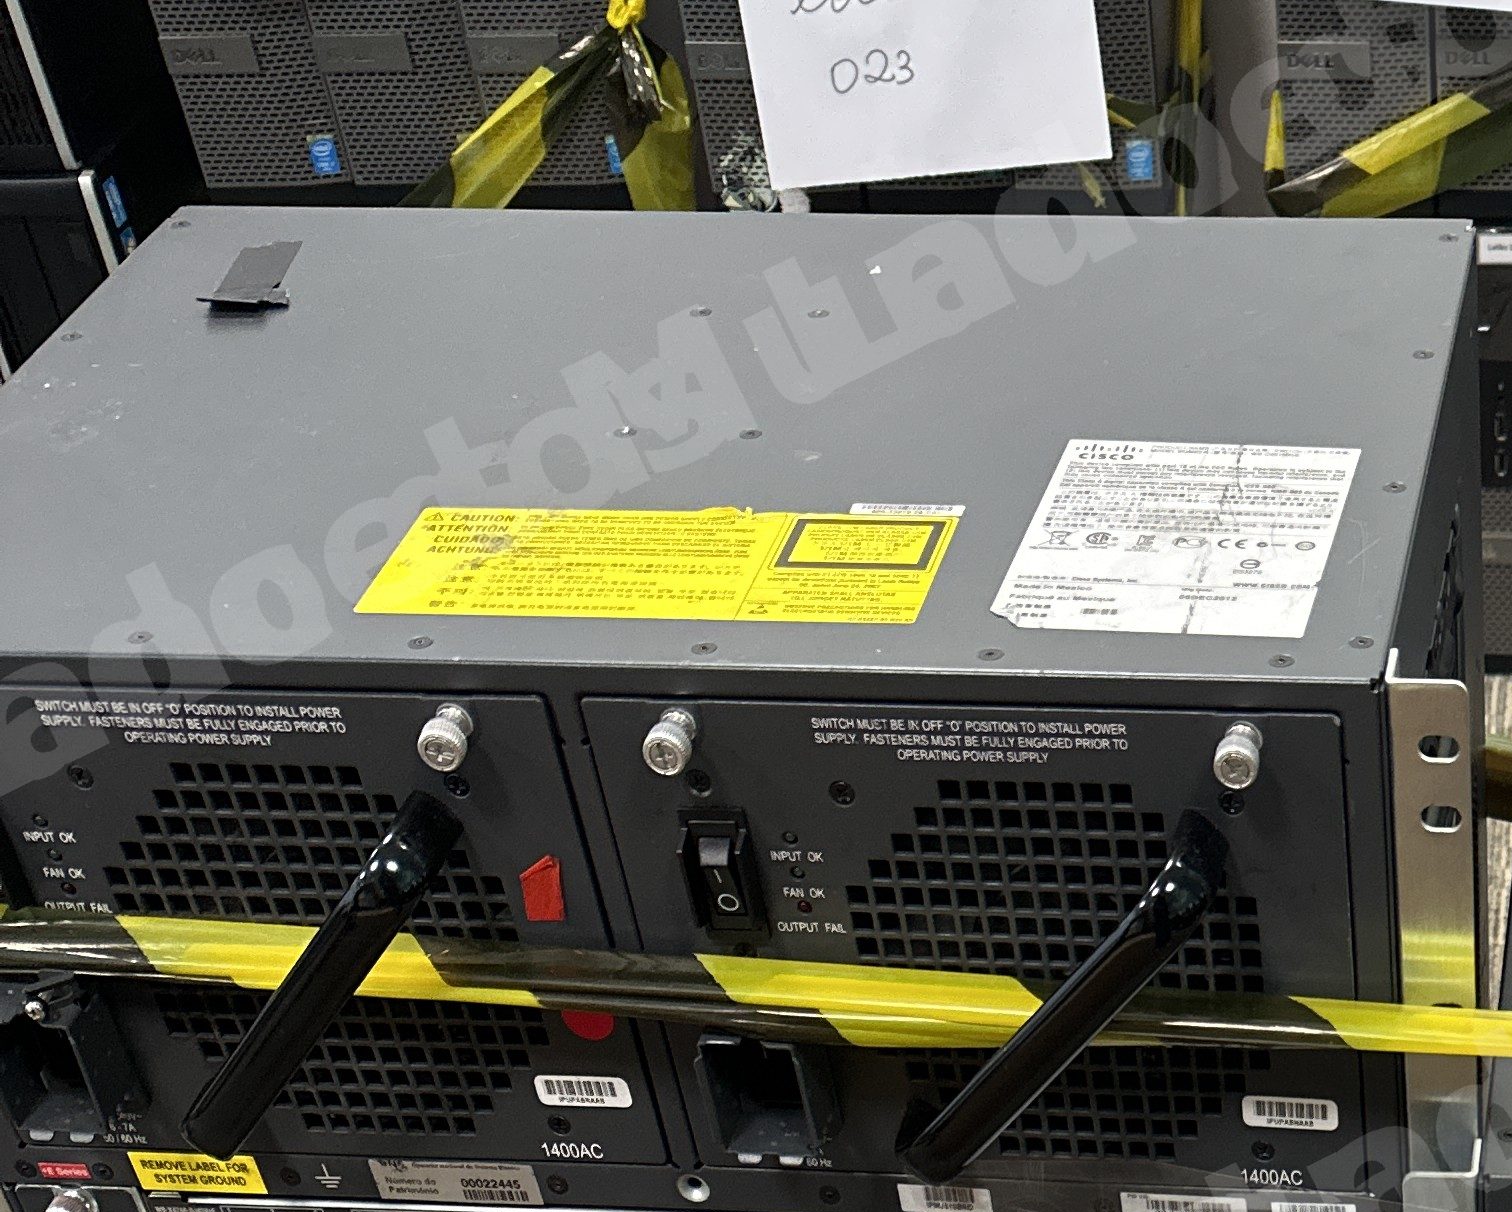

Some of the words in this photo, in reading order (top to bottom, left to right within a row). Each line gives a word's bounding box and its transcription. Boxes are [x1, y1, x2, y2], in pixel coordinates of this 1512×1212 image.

[830, 48, 915, 94] 023
[35, 700, 79, 713] SWITCH
[80, 701, 109, 714] MUST
[111, 701, 128, 714] BE
[130, 702, 140, 715] IN
[141, 702, 164, 715] OFF
[184, 703, 235, 717] POSITION
[238, 705, 253, 717] TO
[255, 705, 299, 718] INSTALL
[300, 706, 342, 719] POWER
[89, 716, 152, 730] FASTENERS
[153, 717, 184, 730] MUST
[186, 718, 202, 731] BE
[204, 718, 235, 731] FULLY
[238, 719, 292, 732] ENGAGED
[294, 720, 329, 733] PRIOR
[330, 721, 346, 734] TO
[811, 718, 855, 731] SWITCH
[857, 719, 888, 731] MUST
[890, 719, 905, 732] BE
[921, 720, 944, 732] OFF
[965, 720, 1018, 733] POSITION
[1020, 721, 1036, 733] TO
[1039, 722, 1082, 734] INSTALL
[1084, 722, 1127, 735] POWER
[124, 731, 187, 745] OPERATING
[188, 732, 229, 746] POWER
[231, 733, 272, 746] SUPPLY
[863, 734, 929, 747] FASTENERS
[931, 735, 963, 747] MUST
[964, 735, 980, 748] BE
[982, 736, 1014, 748] FULLY
[1018, 736, 1073, 749] ENGAGED
[1075, 737, 1110, 750] PRIOR
[1111, 738, 1128, 750] TO
[897, 749, 961, 762] OPERATING
[963, 750, 1004, 763] POWER
[1006, 751, 1049, 764] SUPPLY
[22, 830, 54, 843] INPUT
[59, 831, 78, 844] OK
[769, 850, 802, 862] INPUT
[807, 851, 824, 863] OK
[43, 866, 65, 879] FAN
[68, 867, 87, 880] OK
[783, 886, 805, 899] FAN
[809, 888, 826, 899] OK
[89, 903, 114, 914] FAIL
[776, 921, 819, 933] OUTPUT
[824, 922, 847, 934] FAIL
[541, 1142, 604, 1160] 1400AC
[140, 1159, 188, 1172] REMOVE
[190, 1160, 225, 1172] LABEL
[226, 1162, 250, 1174] FOR
[154, 1172, 199, 1184] SYSTEM
[199, 1174, 248, 1186] GROUND
[460, 1178, 521, 1190] 00022445
[1240, 1168, 1304, 1186] 1400AC
